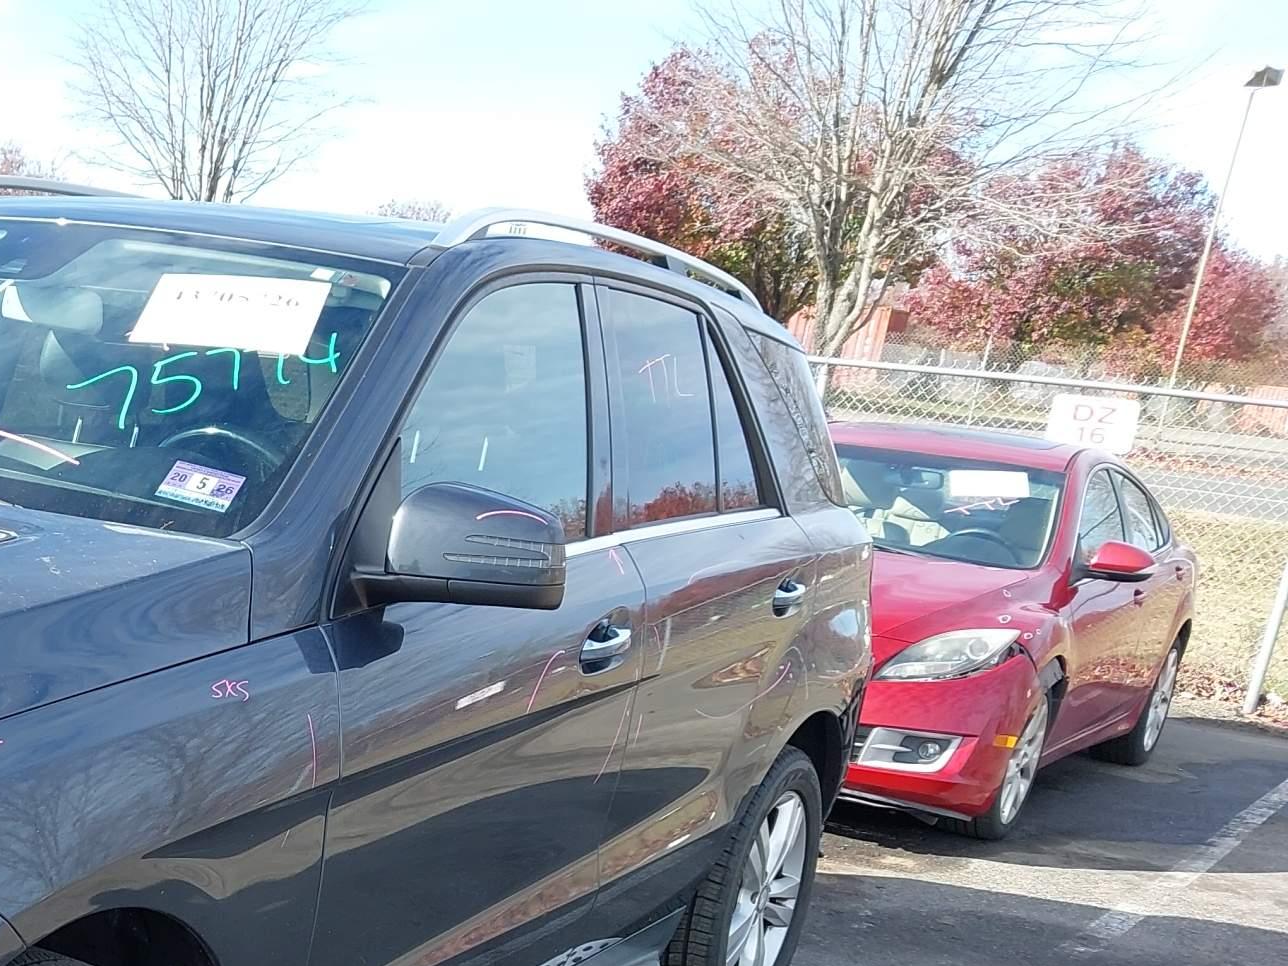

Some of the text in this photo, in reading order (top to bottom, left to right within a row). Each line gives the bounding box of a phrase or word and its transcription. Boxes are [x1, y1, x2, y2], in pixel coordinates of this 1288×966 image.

[1073, 404, 1118, 424] DZ
[1078, 426, 1105, 443] 16
[170, 472, 235, 495] 20 5 26
